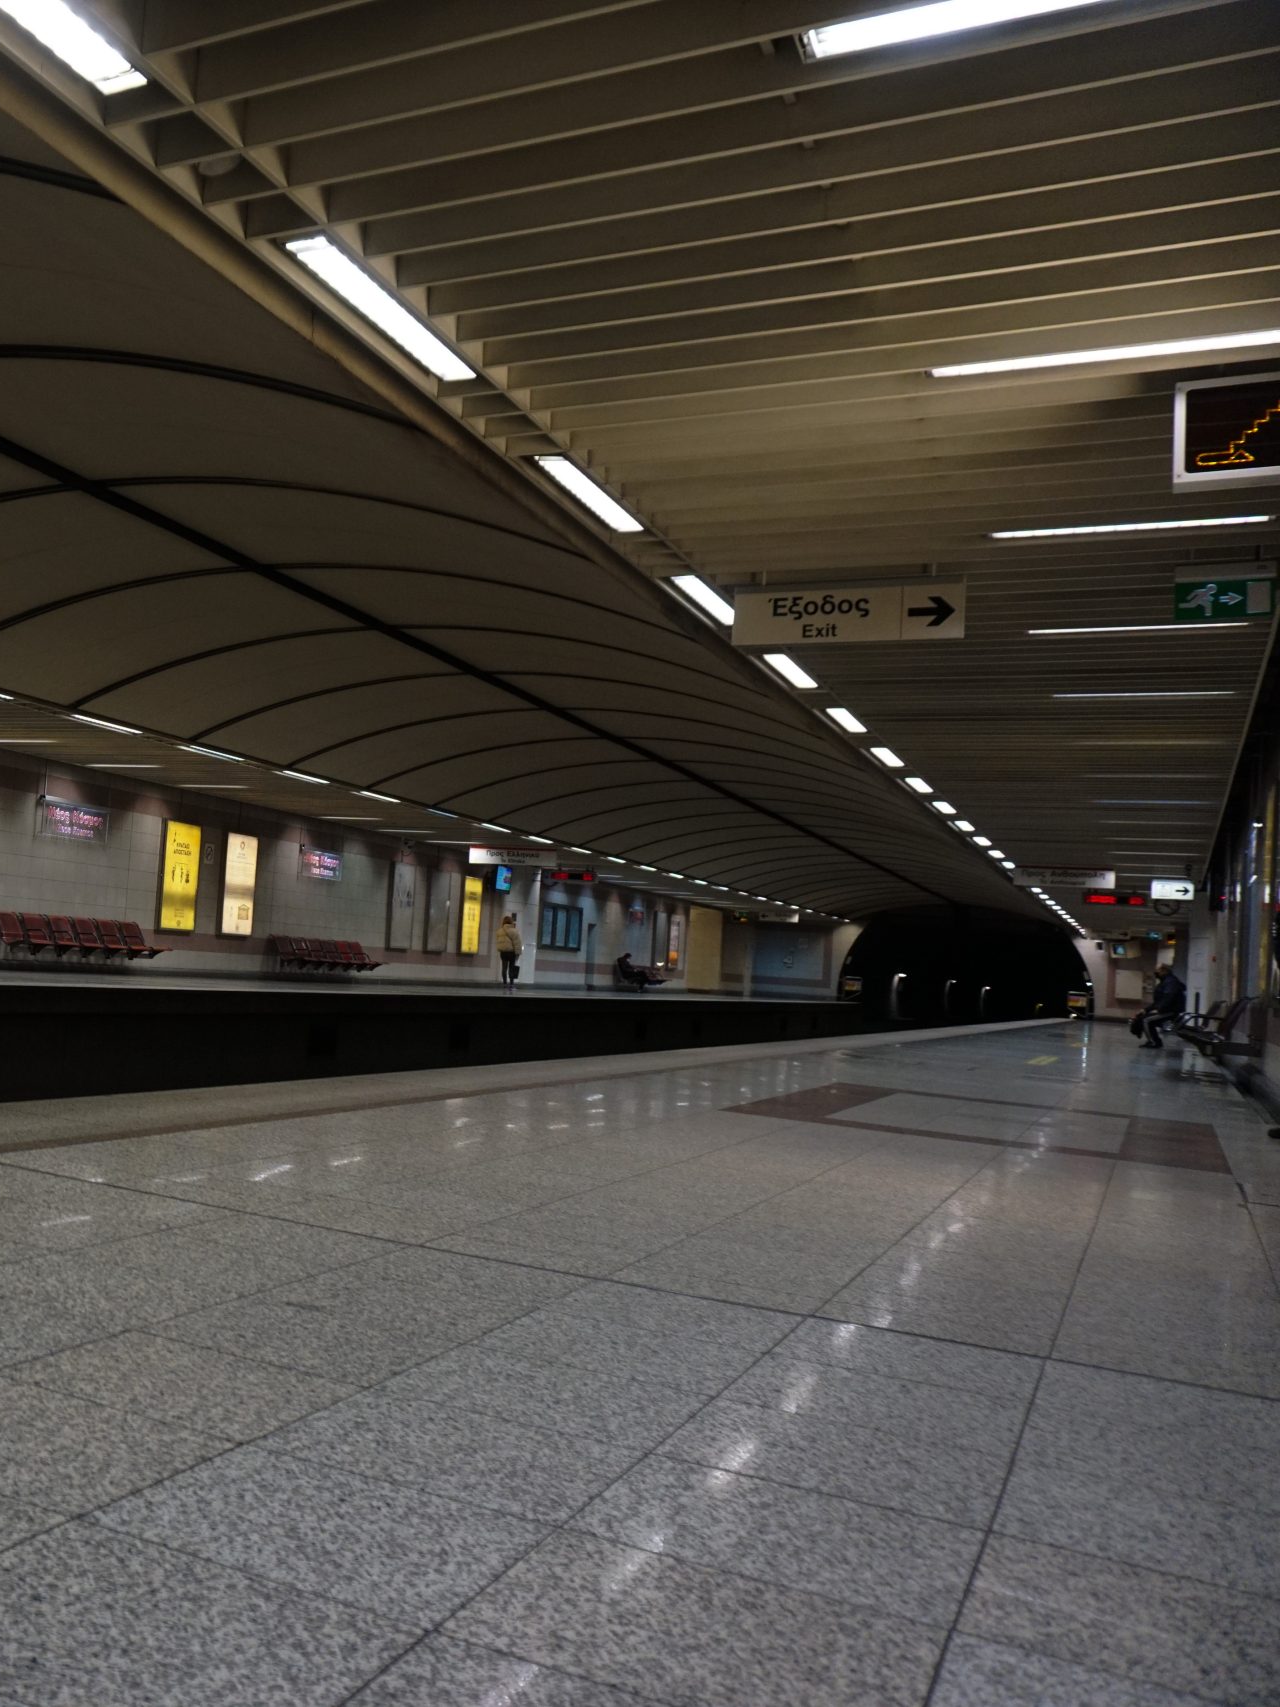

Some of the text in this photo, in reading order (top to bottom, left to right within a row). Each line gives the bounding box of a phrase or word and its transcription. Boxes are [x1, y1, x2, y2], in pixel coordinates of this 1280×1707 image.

[768, 595, 870, 620] Έξοδος
[802, 624, 837, 639] Exit
[486, 849, 504, 858] Προς
